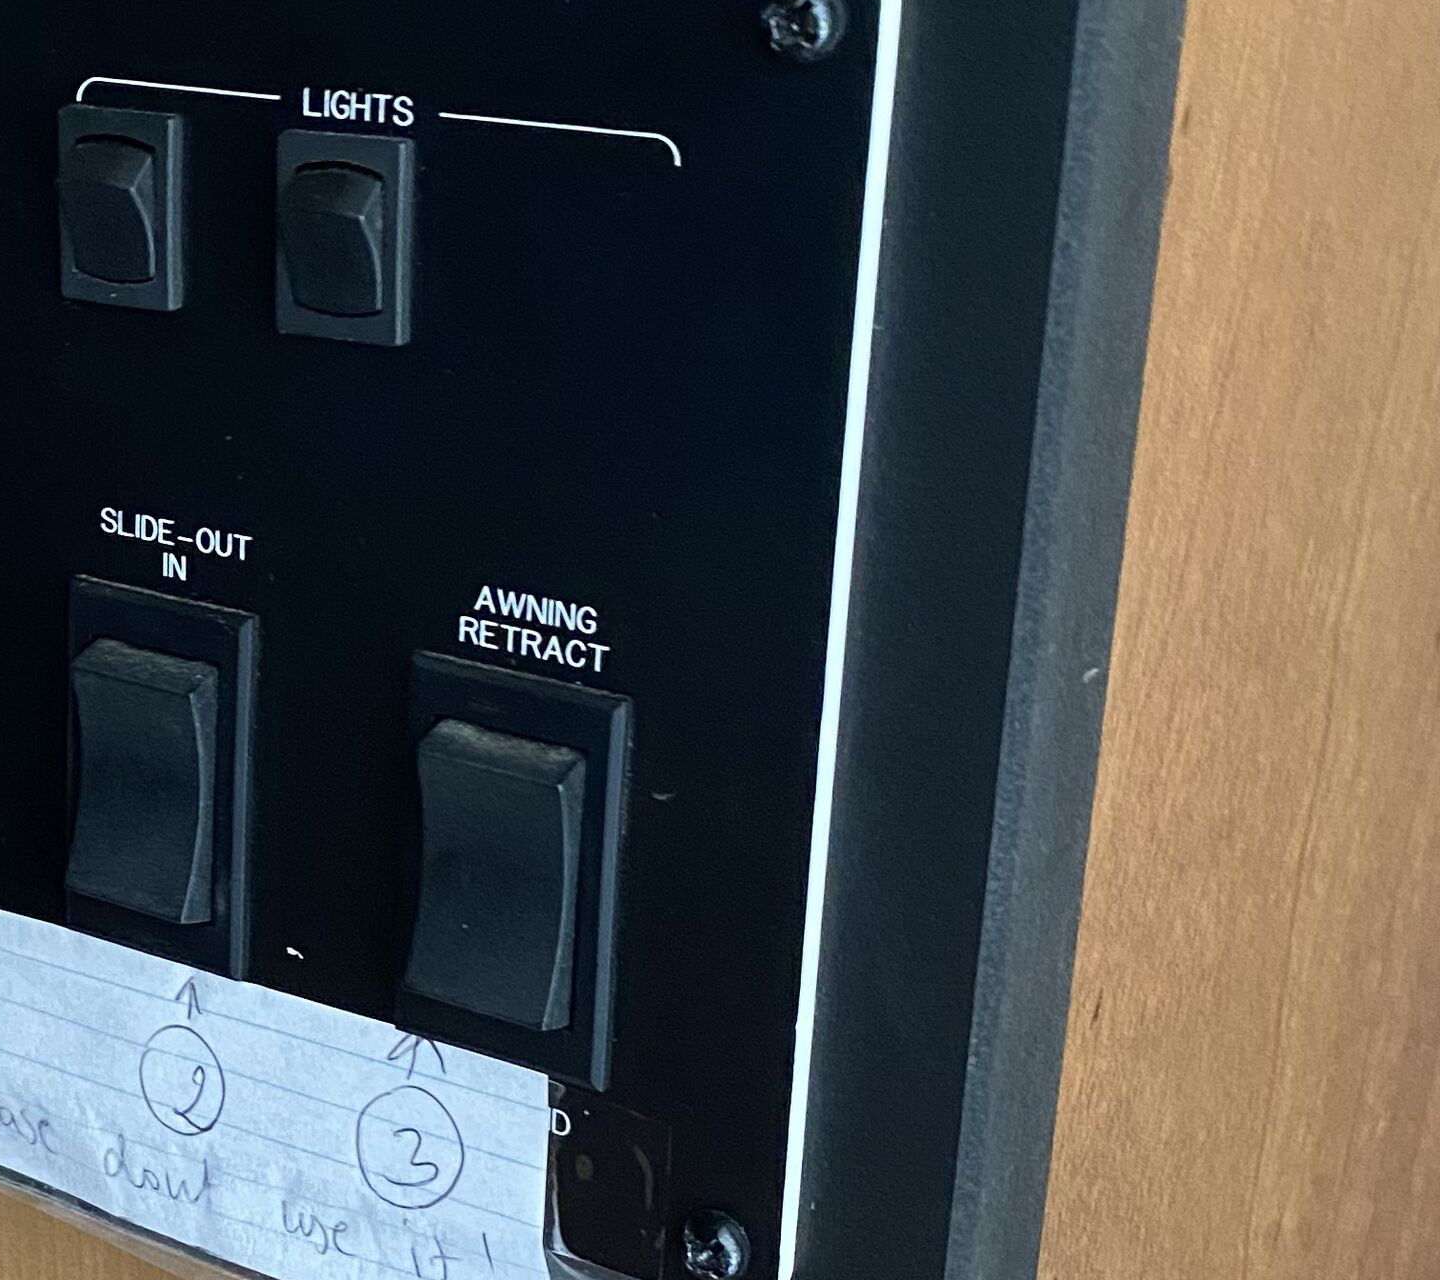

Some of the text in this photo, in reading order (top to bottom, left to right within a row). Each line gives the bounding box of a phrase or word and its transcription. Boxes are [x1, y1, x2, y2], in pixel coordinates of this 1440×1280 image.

[303, 87, 414, 126] LIGHTS
[101, 507, 252, 562] SLIDE-OUT
[163, 552, 186, 581] IN
[473, 586, 597, 634] AWNING
[456, 616, 610, 672] RETRACT
